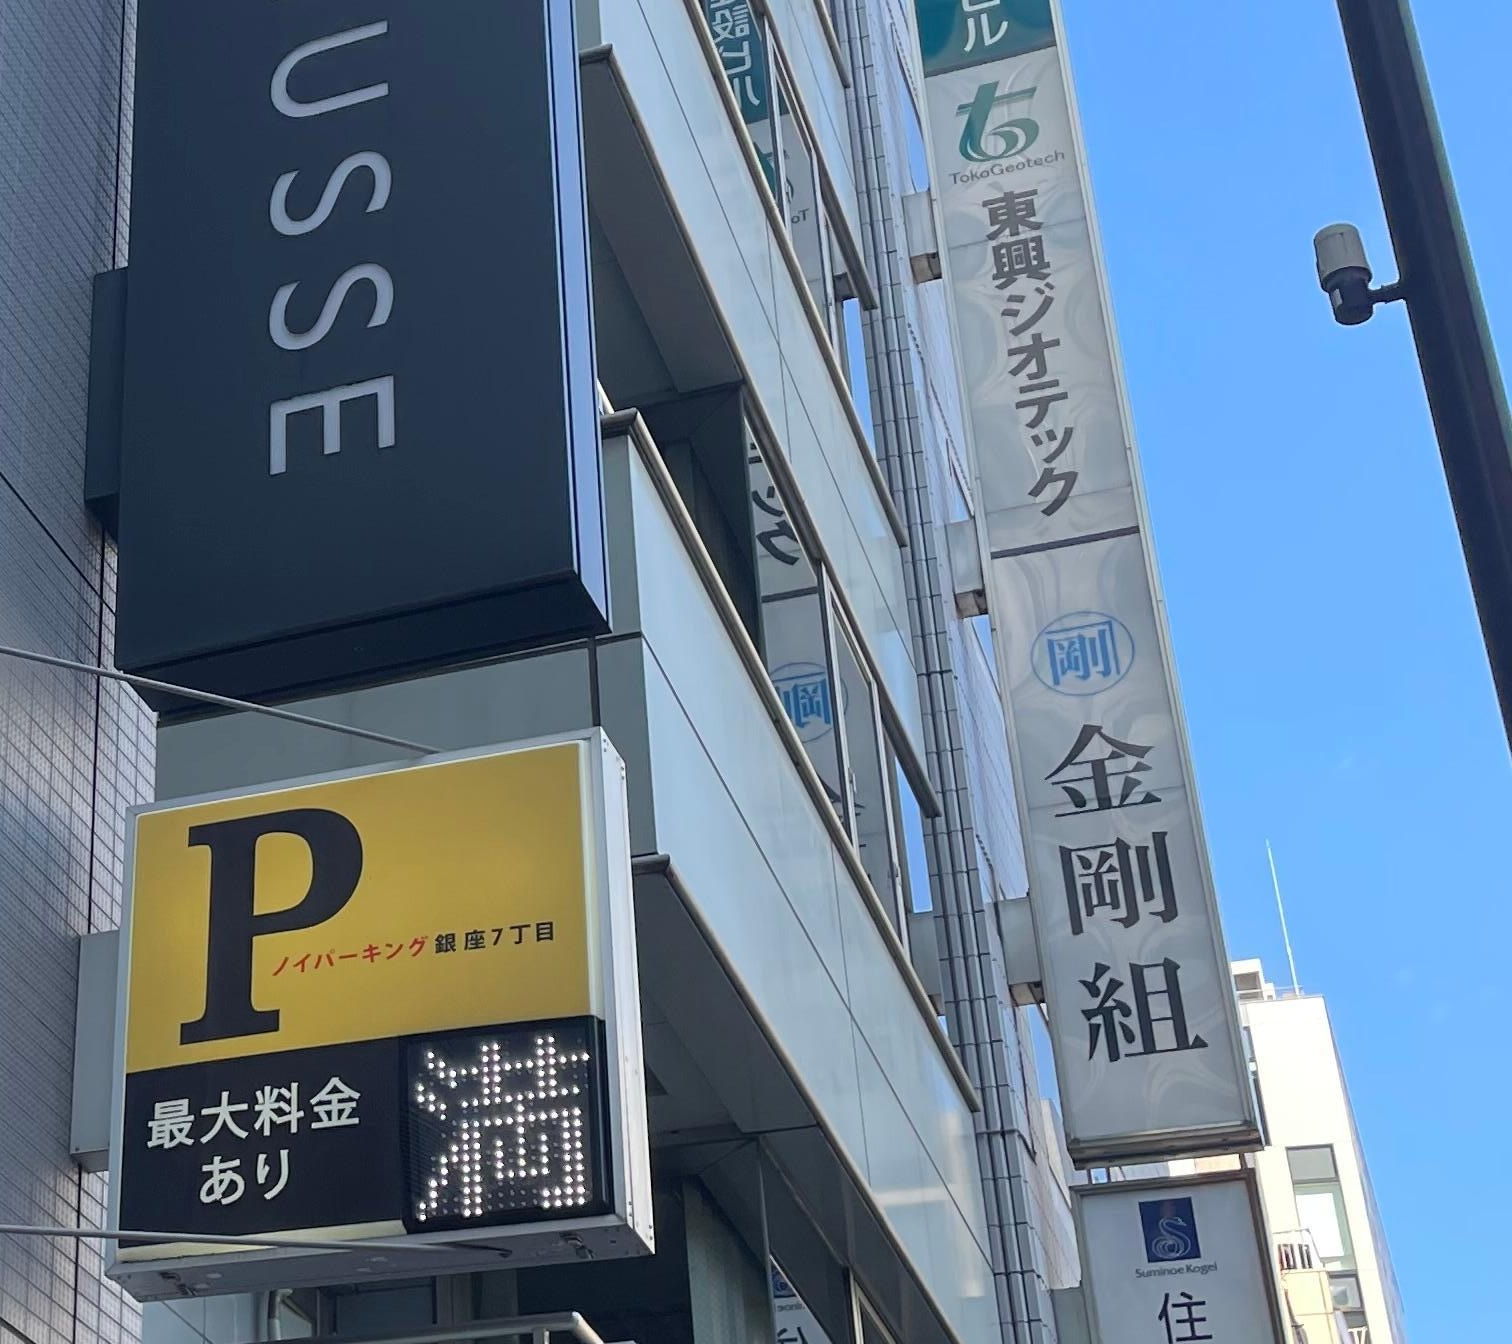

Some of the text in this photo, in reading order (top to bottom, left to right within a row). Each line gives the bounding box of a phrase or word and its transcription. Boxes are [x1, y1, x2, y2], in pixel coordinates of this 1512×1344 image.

[949, 149, 1065, 185] TokoGeotech
[981, 187, 1079, 518] 東興ジオテック
[179, 807, 364, 1046] P
[1044, 723, 1209, 1064] 金剛組
[271, 920, 555, 977] ノイパーキング 銀座7丁目
[146, 1076, 362, 1150] 最大料金
[415, 1035, 591, 1223] 満
[198, 1148, 290, 1207] あり
[1135, 1260, 1218, 1279] Suminoe Kogei
